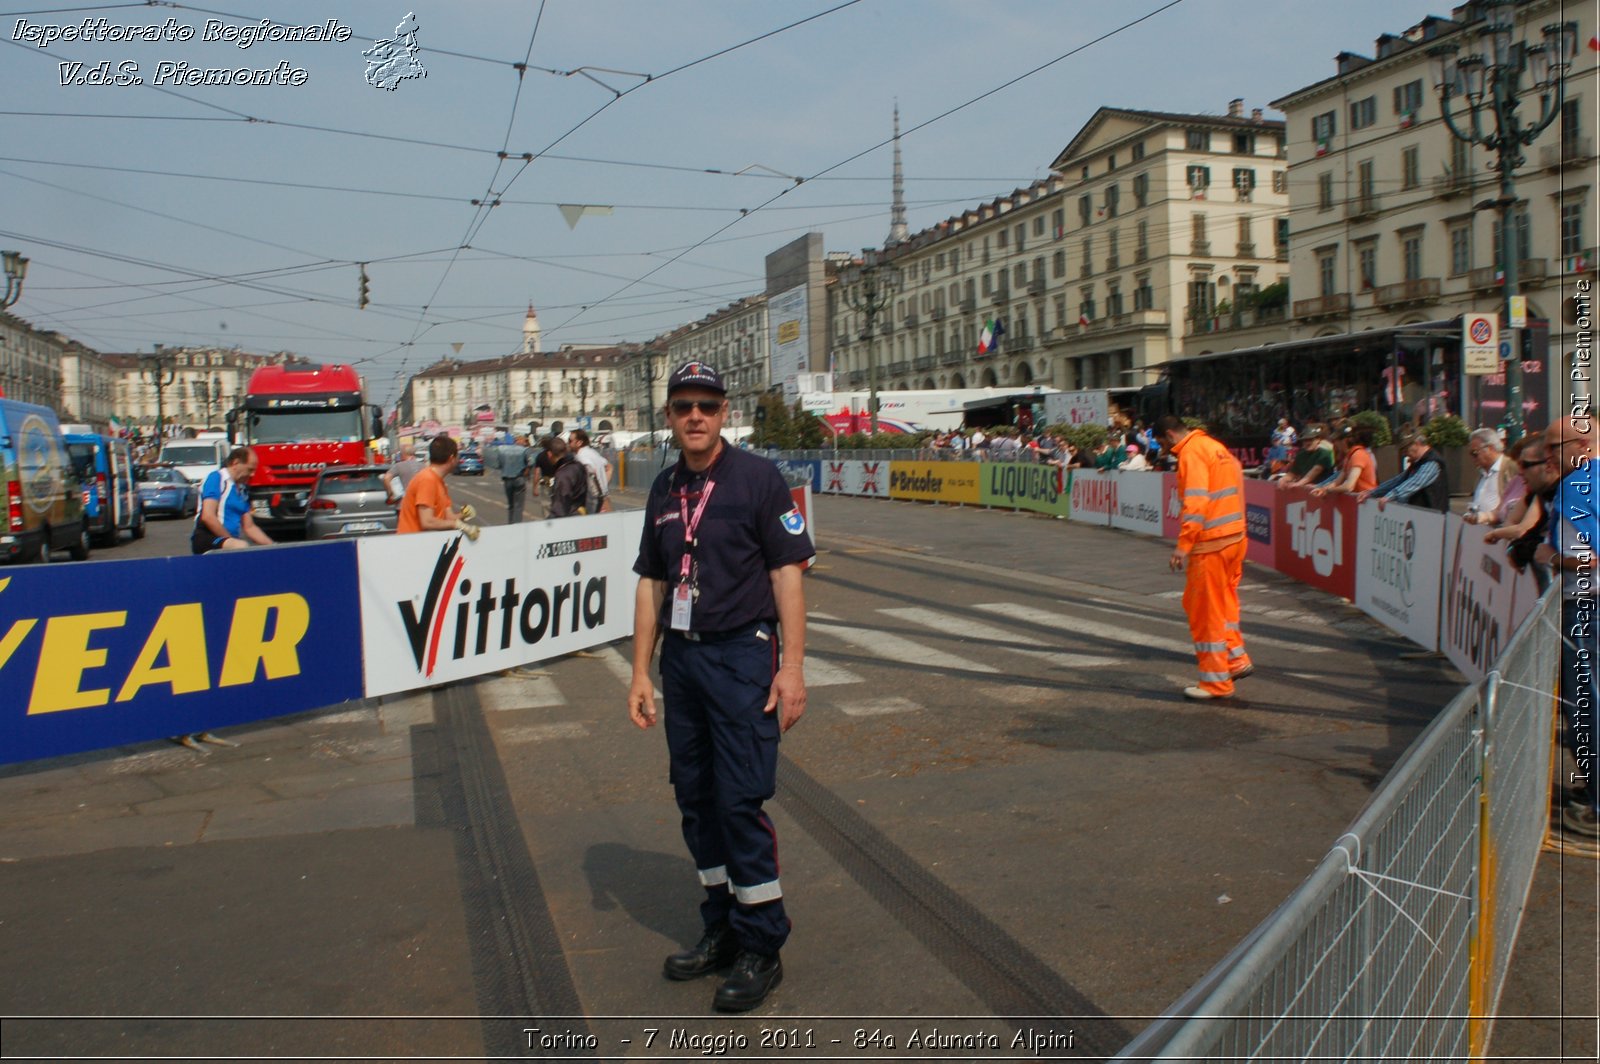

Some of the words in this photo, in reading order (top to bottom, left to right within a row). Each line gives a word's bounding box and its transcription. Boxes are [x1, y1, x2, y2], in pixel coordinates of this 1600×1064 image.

[287, 462, 328, 472] IVECO
[899, 469, 943, 494] Bricofer
[991, 465, 1060, 504] LIQUIGAS
[1081, 478, 1119, 516] YAMAHA
[1286, 501, 1343, 578] Tirol
[1374, 514, 1404, 553] HOHE
[1371, 548, 1415, 604] TAUERN
[397, 534, 607, 680] Vittoria
